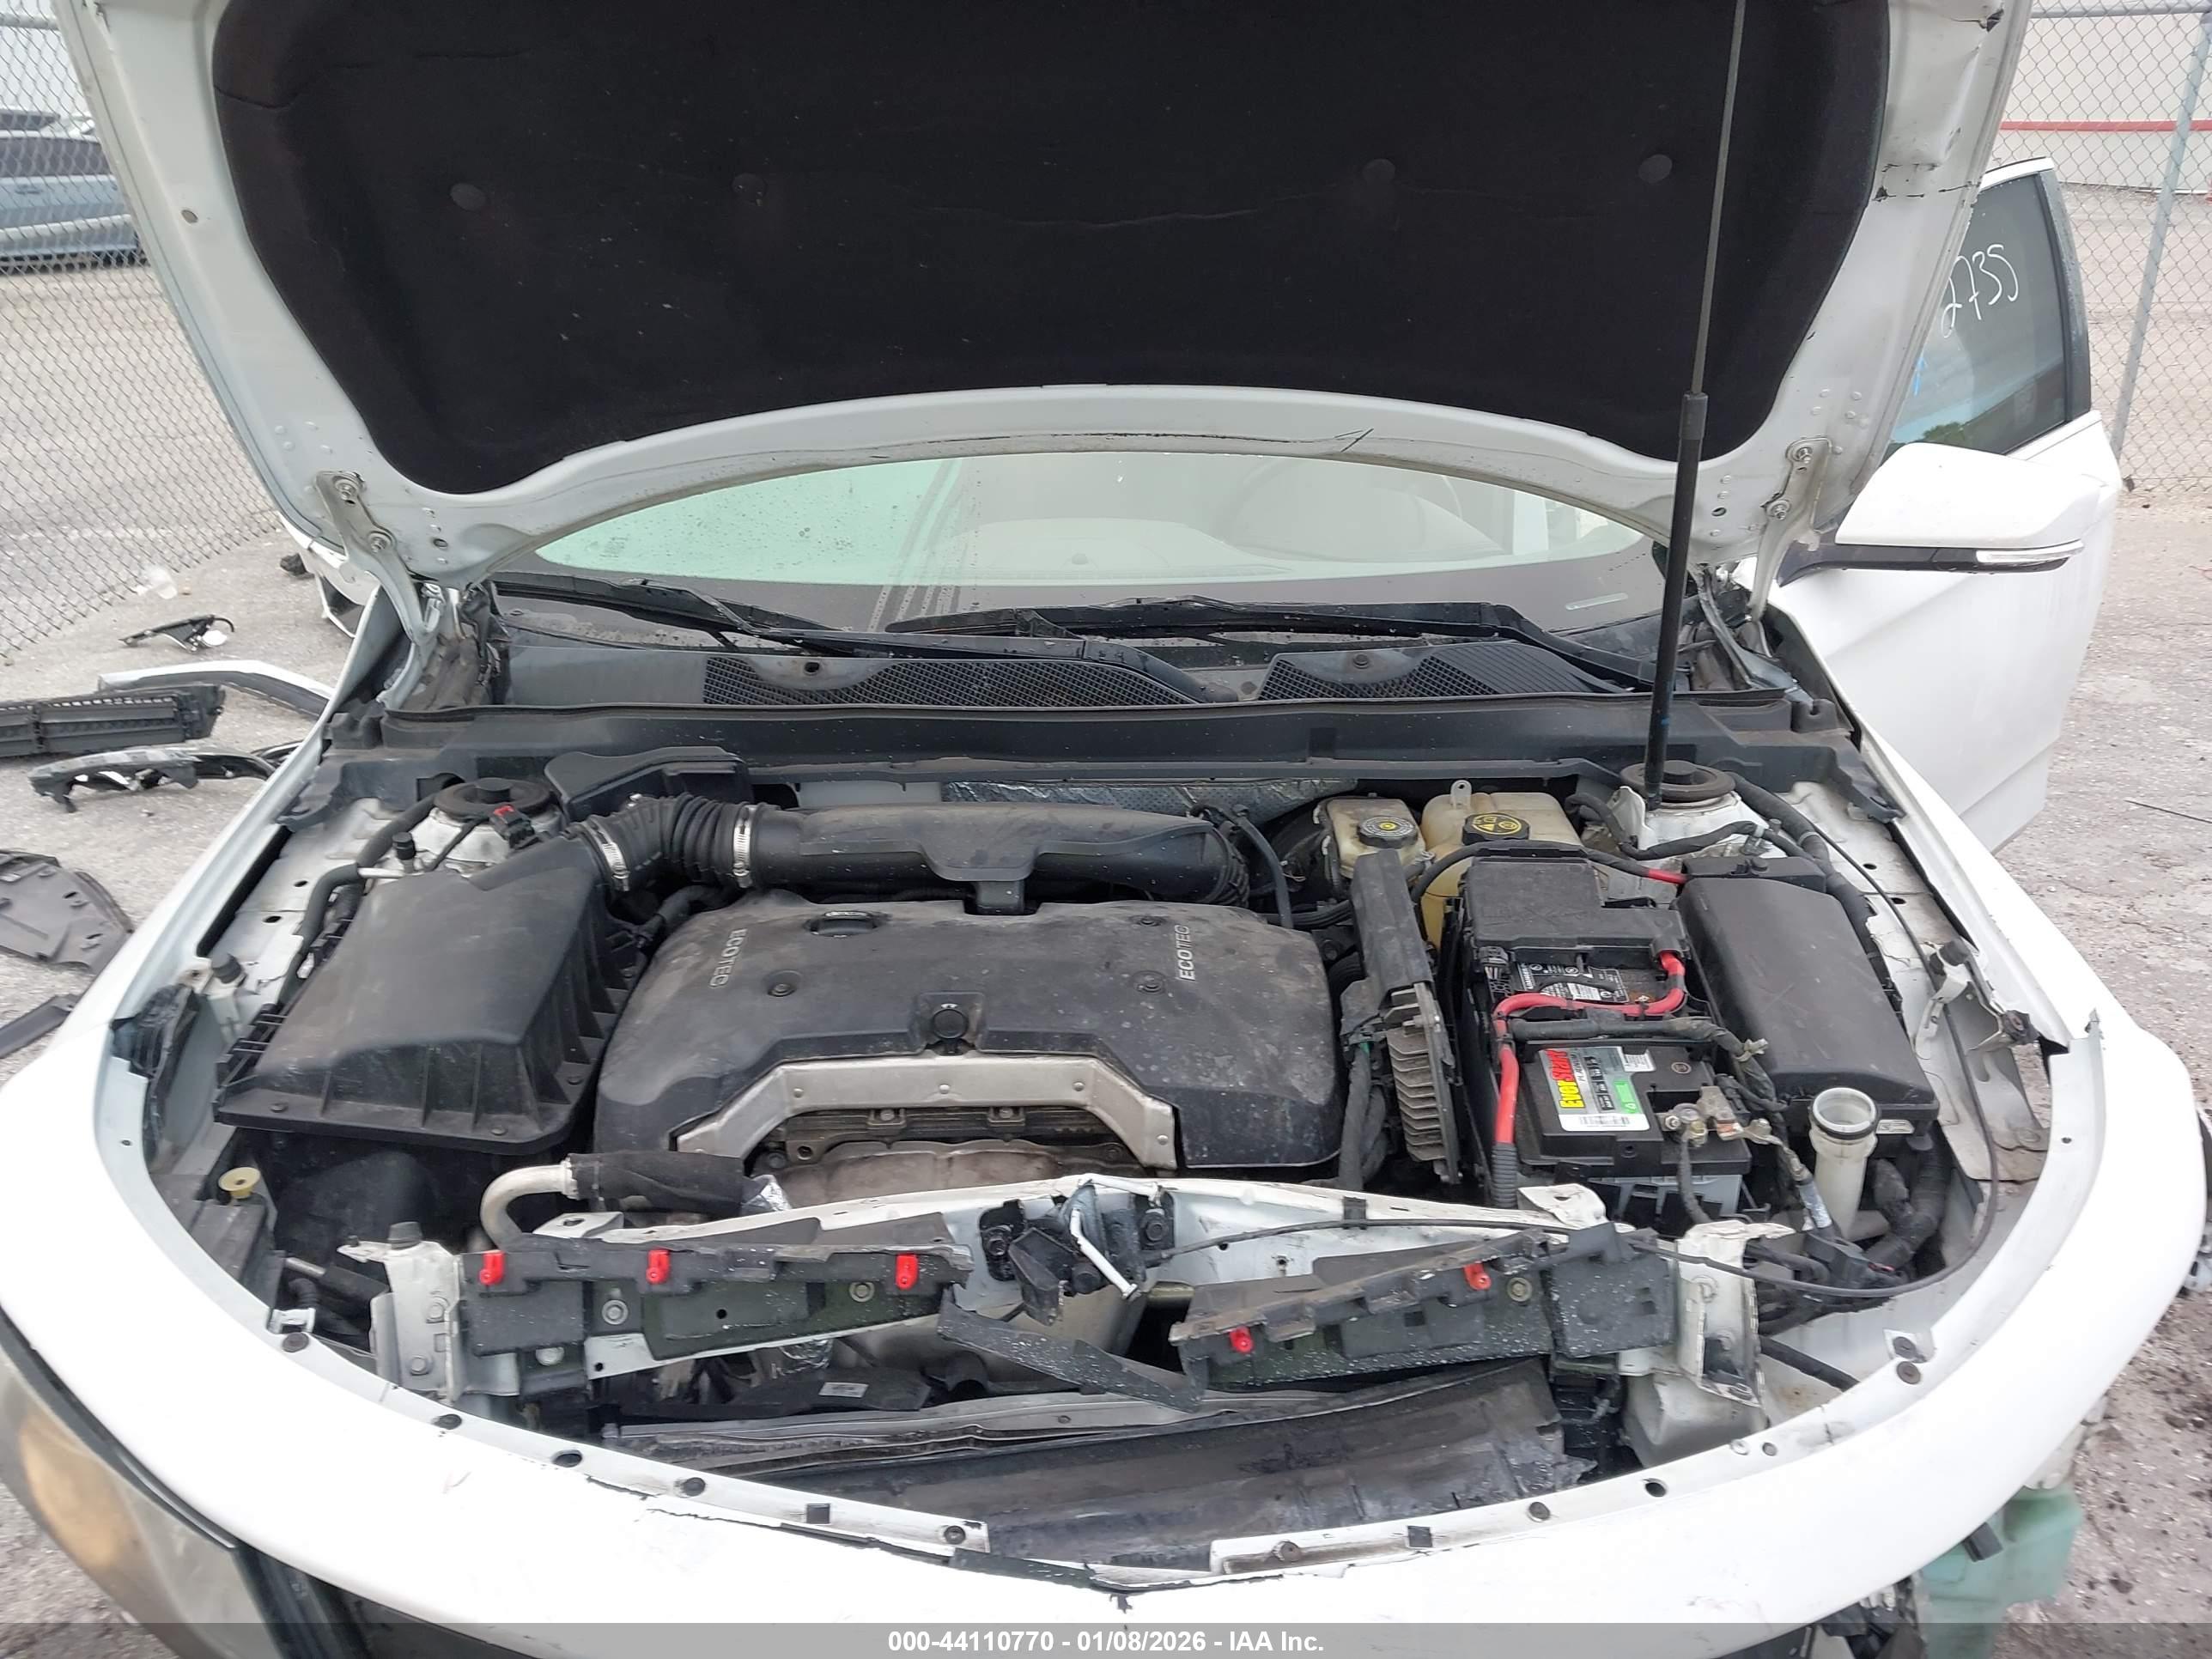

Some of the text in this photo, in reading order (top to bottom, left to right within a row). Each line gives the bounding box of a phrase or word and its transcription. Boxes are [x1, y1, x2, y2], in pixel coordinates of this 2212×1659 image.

[709, 928, 748, 987] ECOTEC
[1174, 924, 1196, 981] ECOTEC
[1546, 1049, 1586, 1108] EverStart
